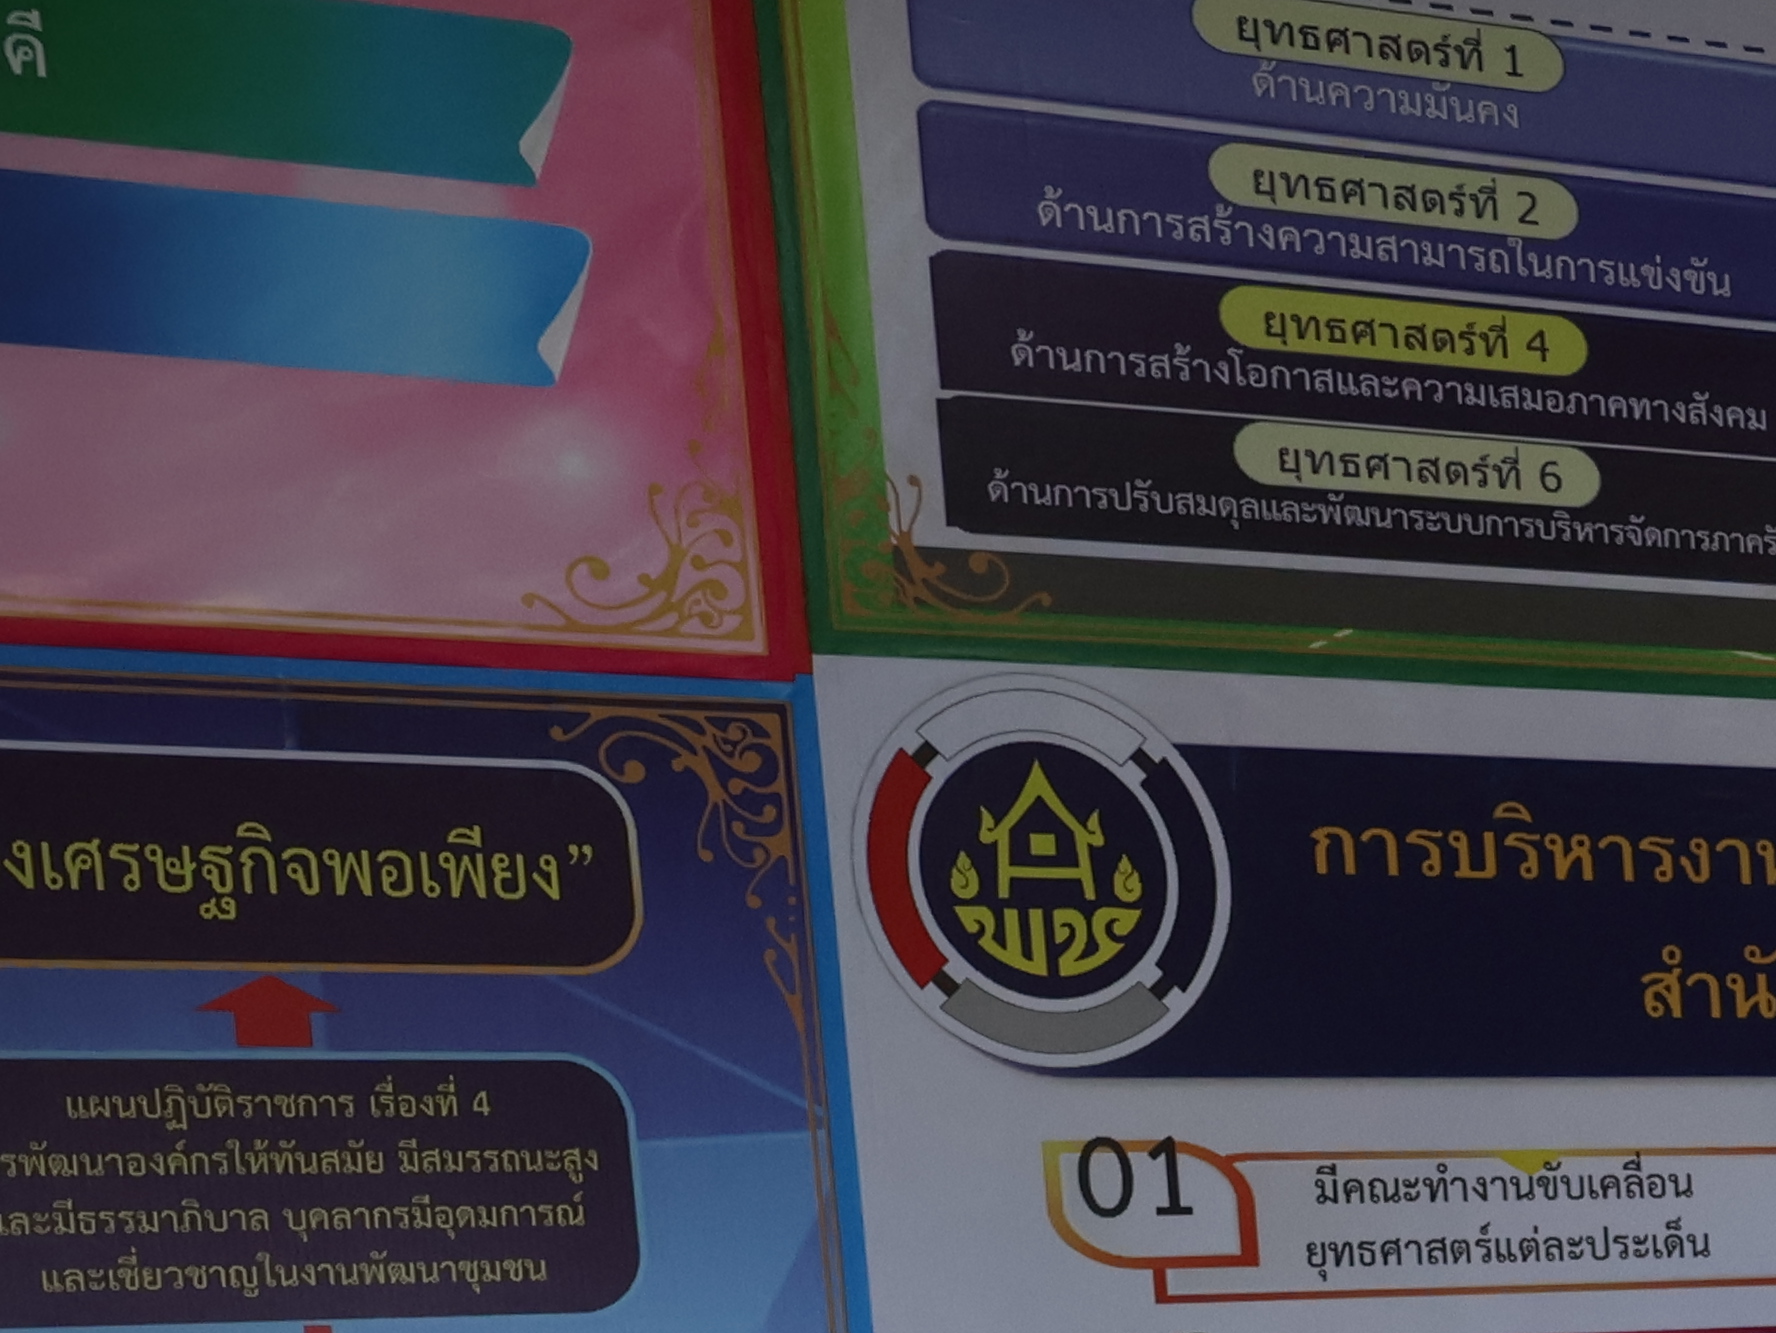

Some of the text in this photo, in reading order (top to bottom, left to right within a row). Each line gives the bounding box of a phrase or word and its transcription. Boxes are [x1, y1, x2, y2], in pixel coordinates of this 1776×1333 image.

[1236, 9, 1524, 80] ยุทธศาสตร์ที่ 1
[1251, 64, 1519, 131] ด้านความมั่นคง
[1252, 161, 1540, 227] ยุทธศาสตร์ที่ 2
[1036, 187, 1731, 298] ด้านการสร้างความสามารถในการแข่งขัน
[1264, 304, 1550, 363] ยุทธศาสตร์ที่ 4
[1010, 333, 1768, 432] ด้านการสร้างโอกาสและความเสมอภาคทางสังคม
[1277, 436, 1563, 495] ยุทธศาสตร์ที่ 6
[65, 1075, 491, 1131] แผนปฏิบัติราชการ เรื่องที่ 4
[398, 1138, 599, 1186] มีสมรรถนะสูง
[1076, 1136, 1194, 1219] 01
[1316, 1150, 1693, 1205] มีคณะทำงานขับเคลื่อน
[283, 1188, 586, 1242] บุคลากรมีอุดมการณ์
[41, 1245, 548, 1298] และเชี่ยวชาญในงานพัฒนาชุมชน
[1306, 1225, 1711, 1284] ยุทธศาสตร์แต่ละประเด็น
